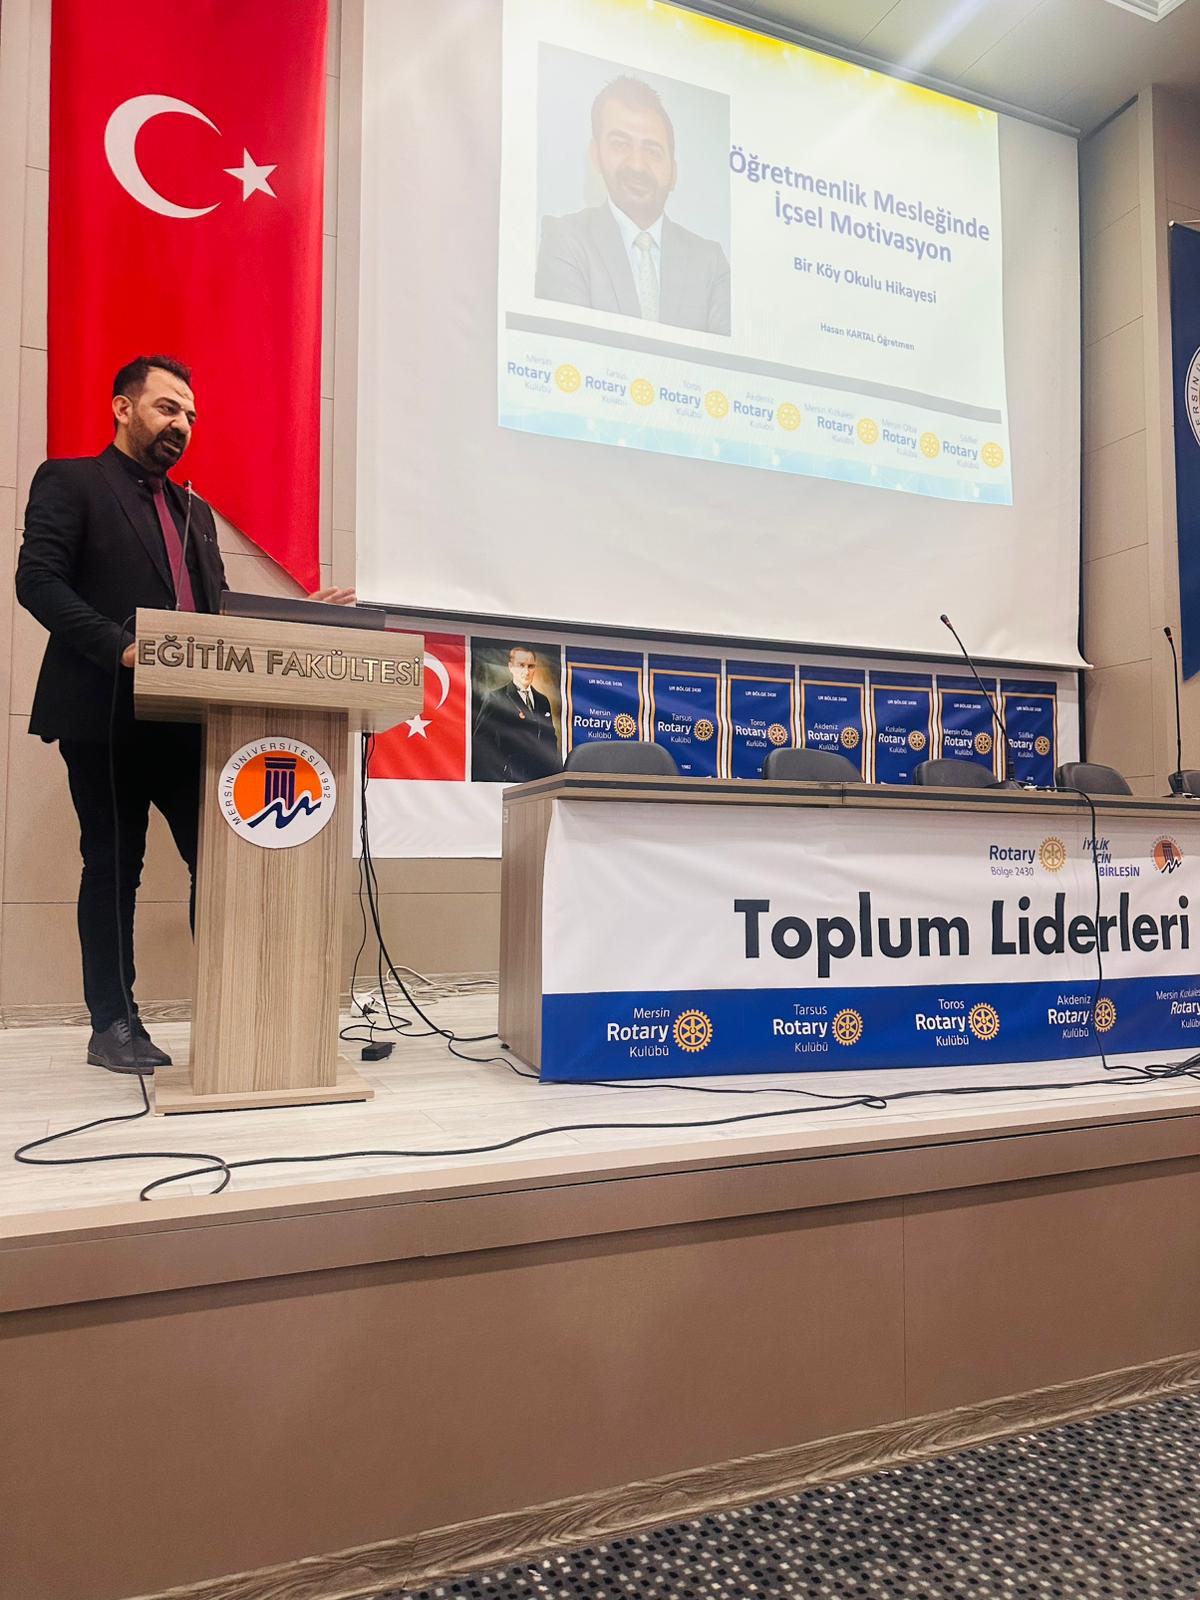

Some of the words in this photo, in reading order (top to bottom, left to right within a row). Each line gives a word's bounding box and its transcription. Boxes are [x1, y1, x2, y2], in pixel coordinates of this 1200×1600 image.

[729, 145, 867, 208] Öğretmenlik
[874, 190, 990, 241] Mesleğinde
[775, 191, 823, 228] İçsel
[831, 211, 952, 263] Motivasyon
[794, 257, 813, 273] Bir
[816, 262, 840, 283] Köy
[844, 270, 882, 290] Okulu
[885, 279, 936, 304] Hikayesi
[820, 322, 844, 335] Hasan
[846, 329, 876, 343] KARTAL
[877, 334, 915, 350] Öğretmen
[507, 361, 551, 383] Rotary
[585, 375, 626, 397] Rotary
[659, 387, 701, 408] Rotary
[733, 401, 774, 422] Rotary
[817, 416, 854, 436] Rotary
[882, 429, 917, 449] Rotary
[942, 441, 978, 460] Rotary
[138, 634, 254, 674] EĞİTİM
[267, 650, 421, 687] FAKÜLTESİ
[589, 708, 611, 717] Mersin
[672, 713, 693, 722] Tarsus
[574, 715, 612, 730] Rotary
[657, 721, 692, 735] Rotary
[750, 719, 766, 727] Toros
[588, 731, 612, 739] Kulübü
[735, 725, 768, 739] Rotary
[807, 730, 840, 743] Rotary
[670, 735, 691, 744] Kulübü
[746, 740, 767, 748] Kulübü
[878, 733, 906, 746] Rotary
[944, 736, 973, 749] Rotary
[1008, 738, 1034, 751] Rotary
[889, 746, 908, 754] Kulübü
[319, 771, 331, 799] 1992
[1082, 837, 1110, 850] İYLİK
[989, 845, 1036, 864] Rotary
[991, 867, 1013, 878] Bölge
[1015, 867, 1034, 877] 2430
[1099, 864, 1140, 878] BİRLEŞİN
[734, 891, 970, 978] Toplum
[992, 892, 1189, 955] Liderleri
[1057, 995, 1091, 1006] Akdeniz
[1156, 990, 1179, 1001] Mersin
[793, 1004, 828, 1016] Tarsus
[938, 999, 965, 1010] Toros
[633, 1007, 671, 1019] Mersin
[1048, 1008, 1090, 1026] Rotary
[772, 1018, 828, 1038] Rotary
[915, 1014, 966, 1033] Rotary
[1181, 1018, 1200, 1029] Kulüb
[607, 1023, 669, 1042] Rotary
[1062, 1027, 1089, 1039] Kulübü
[794, 1041, 829, 1053] Kulübü
[936, 1034, 969, 1047] Kulübü
[629, 1045, 669, 1058] Kulübü
